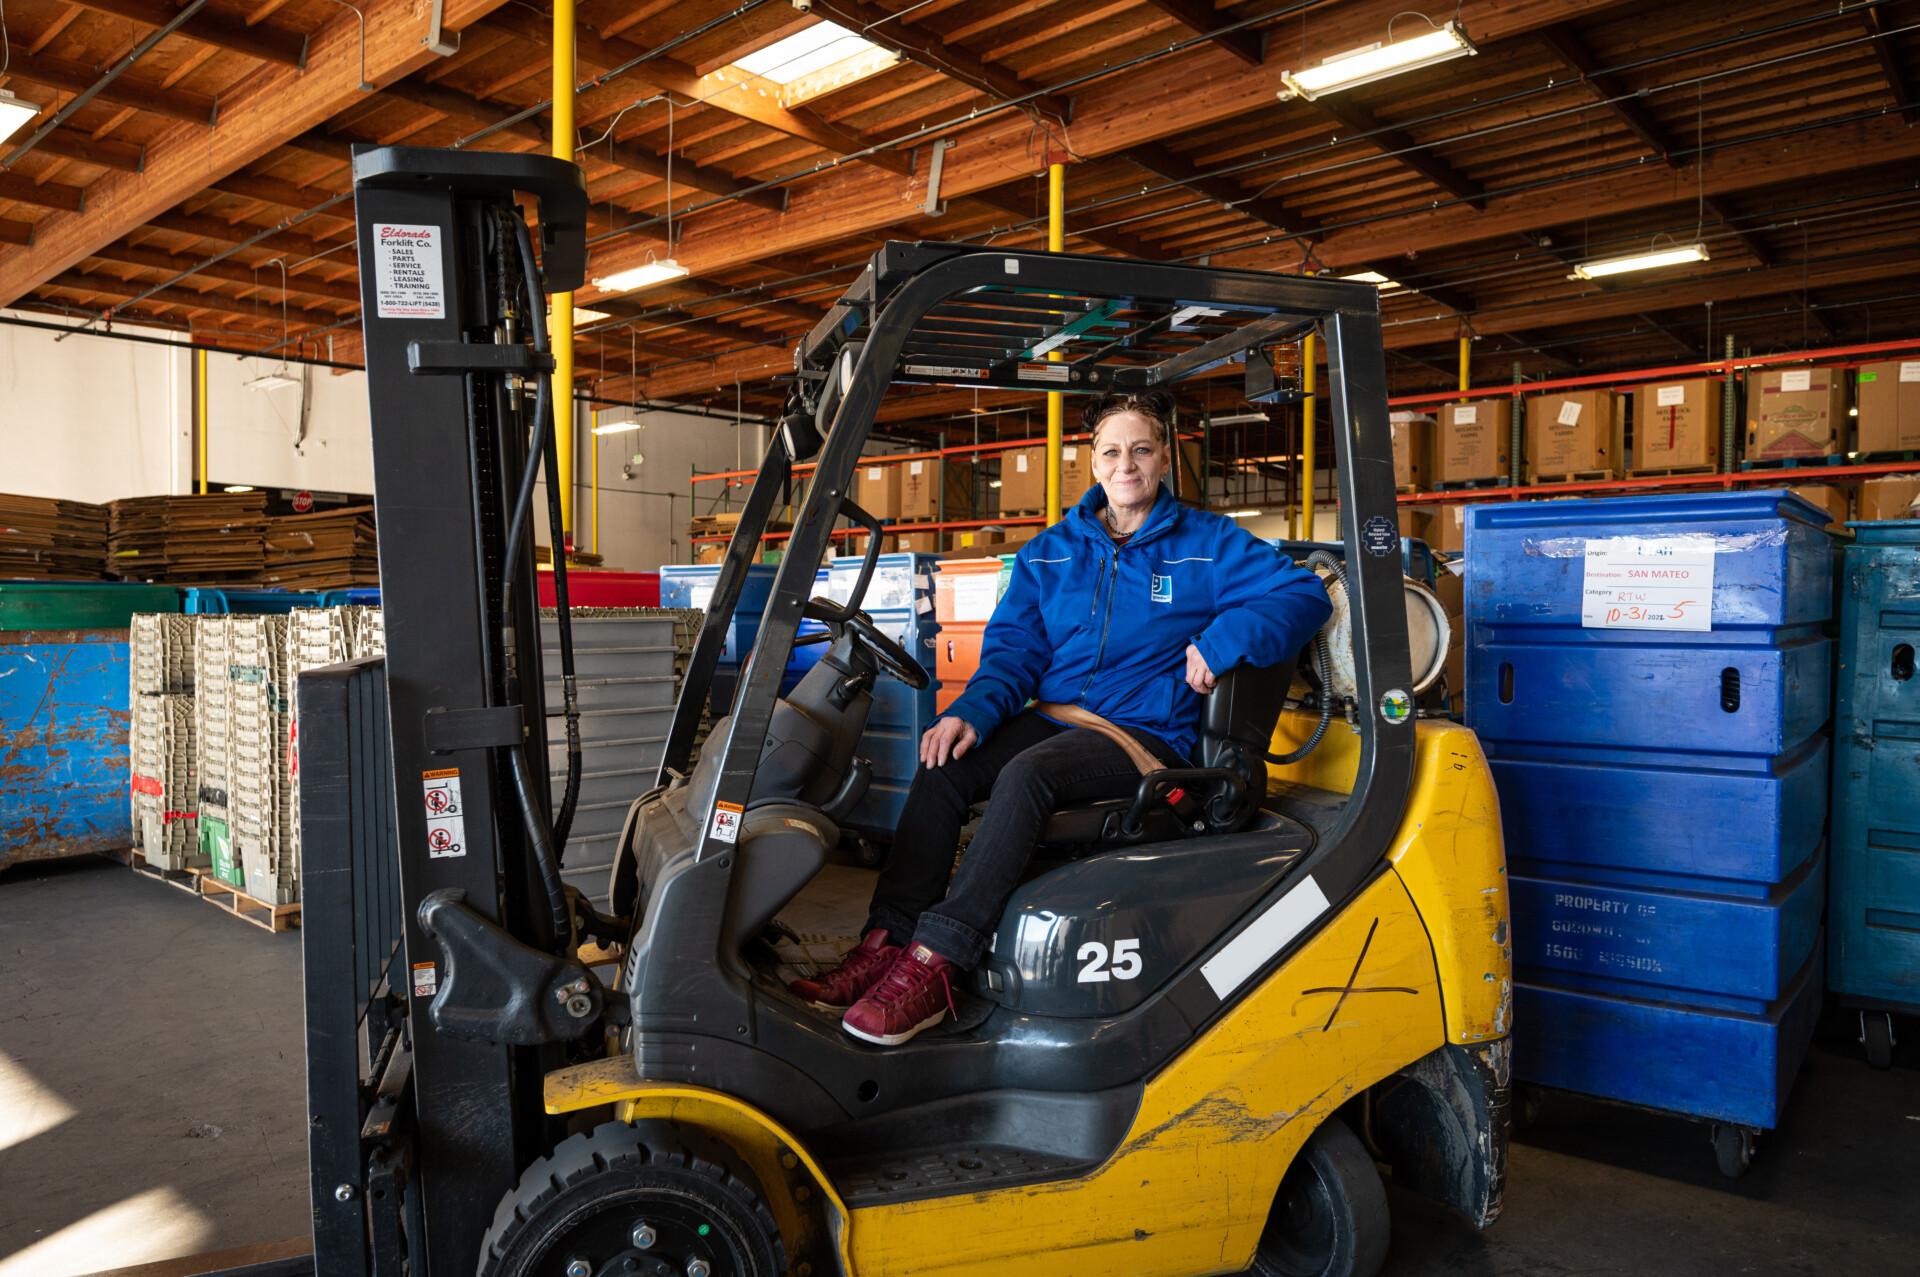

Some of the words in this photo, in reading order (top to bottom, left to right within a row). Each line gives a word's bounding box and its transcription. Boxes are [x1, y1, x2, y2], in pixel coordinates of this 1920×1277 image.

[380, 227, 431, 238] Eldorado
[381, 239, 414, 247] Forklift
[295, 497, 312, 506] STOP
[1638, 546, 1673, 556] UAH
[1628, 570, 1648, 578] SAN
[1652, 570, 1689, 578] MATEO
[1618, 592, 1646, 602] RTW
[1606, 607, 1647, 624] 10-31
[1667, 601, 1696, 619] 5
[1555, 894, 1629, 915] PROPERTY
[1077, 938, 1143, 983] 25
